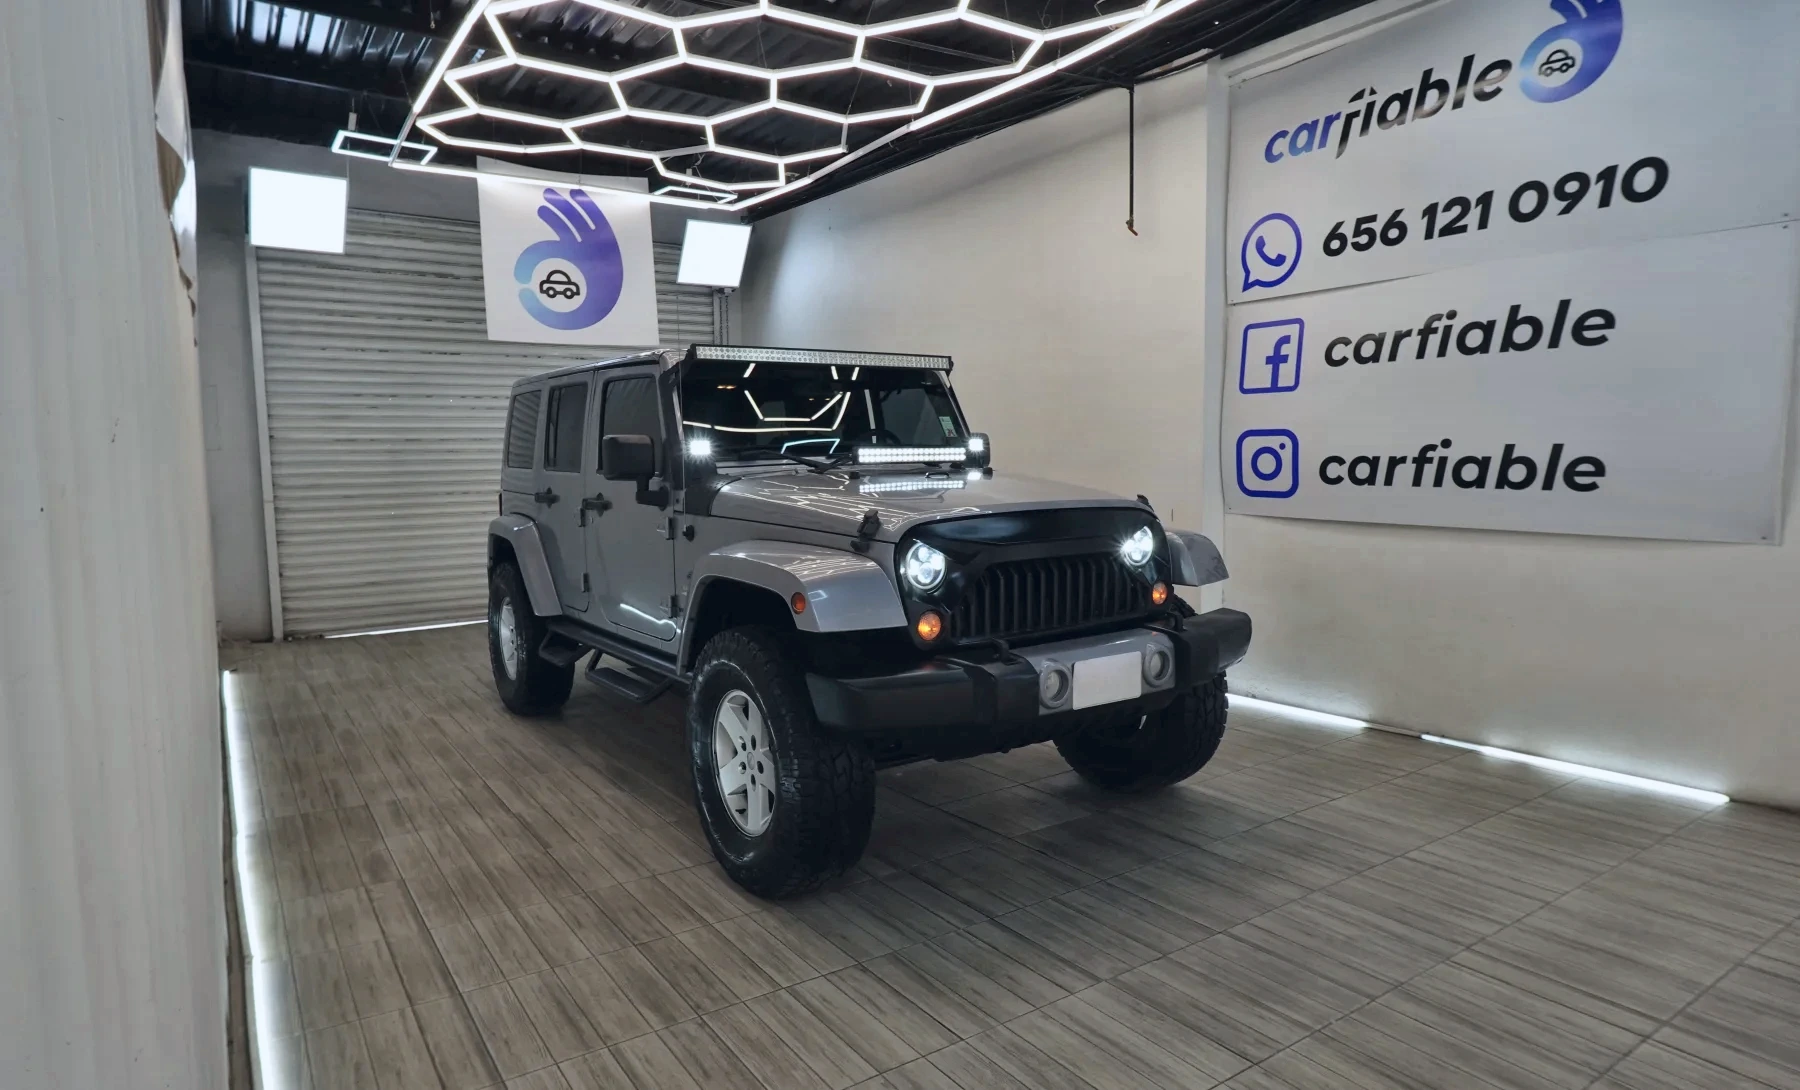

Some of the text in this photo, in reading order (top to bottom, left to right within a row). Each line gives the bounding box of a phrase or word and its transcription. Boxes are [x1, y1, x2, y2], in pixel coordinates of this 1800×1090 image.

[1264, 53, 1513, 164] carfiable
[1322, 156, 1670, 258] 656 121 0910
[1324, 299, 1616, 369] carfiable
[1318, 438, 1607, 493] carfiable
